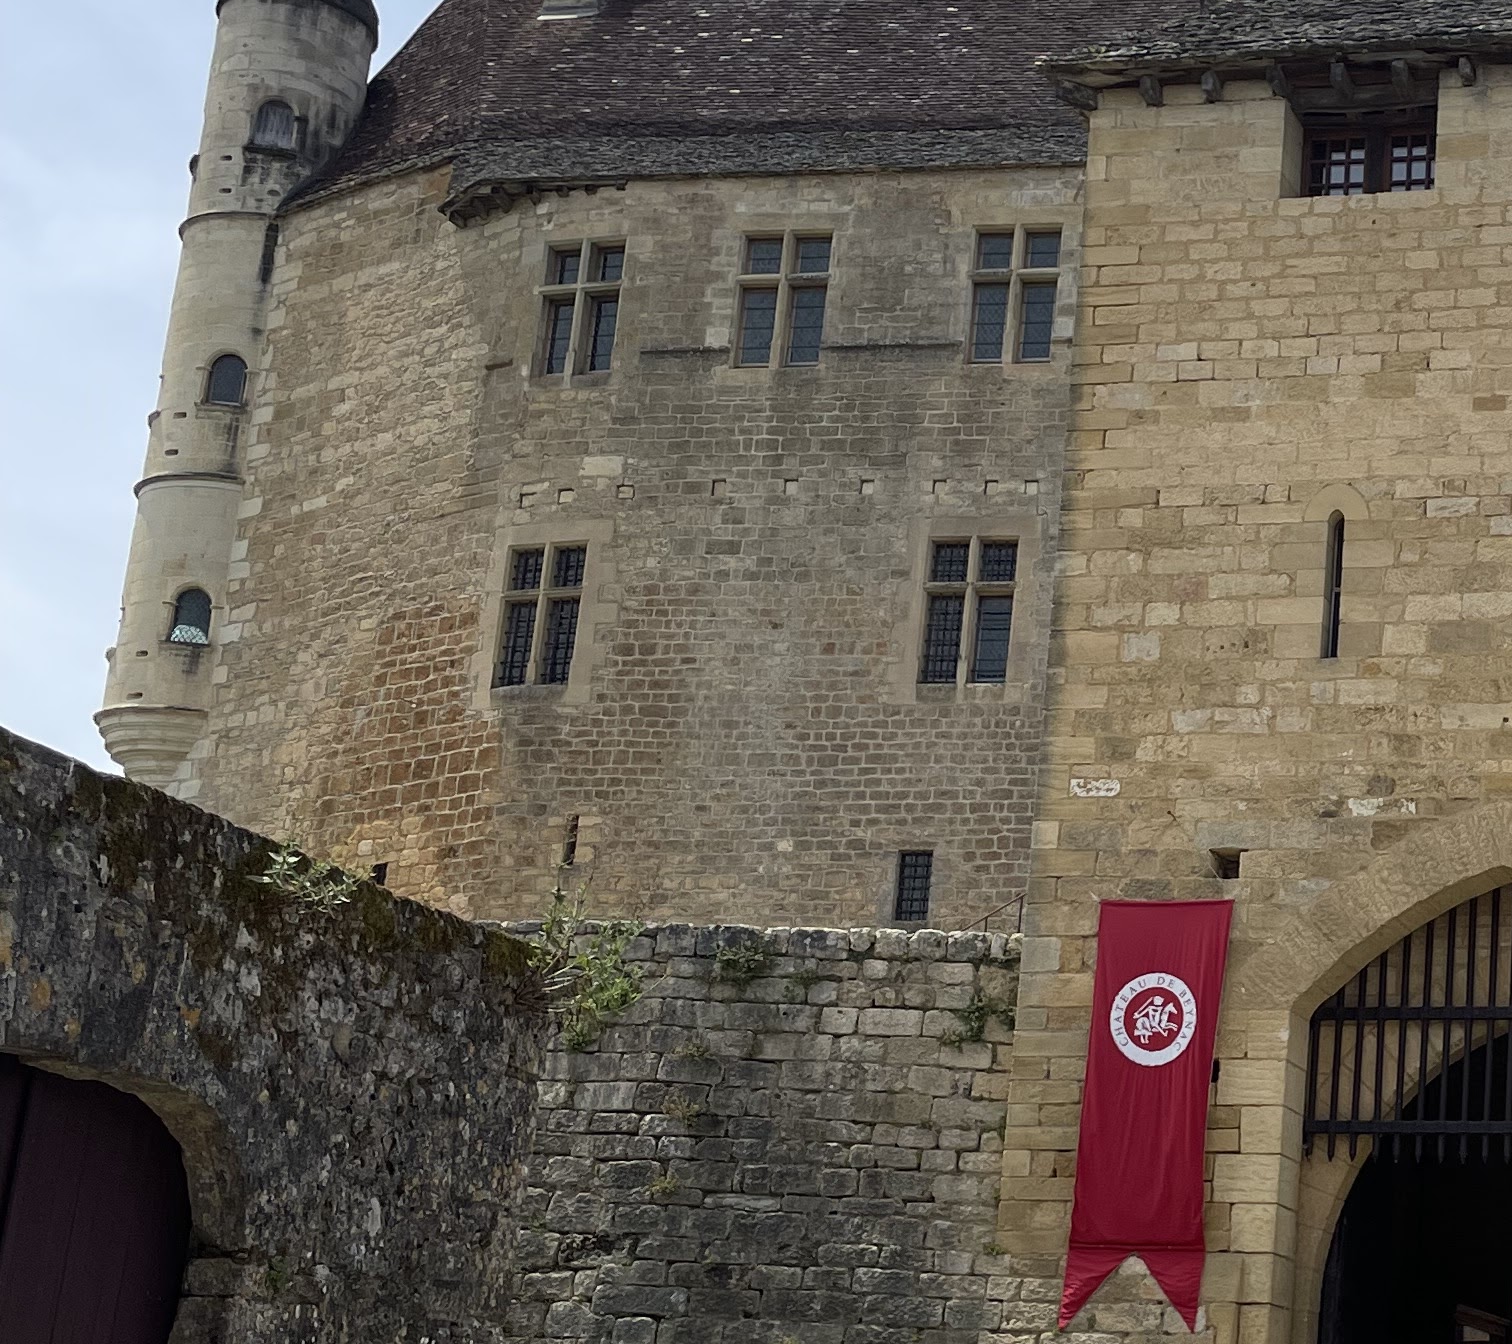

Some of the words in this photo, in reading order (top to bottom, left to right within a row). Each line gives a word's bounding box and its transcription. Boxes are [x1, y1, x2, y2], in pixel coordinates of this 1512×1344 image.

[1113, 979, 1147, 1047] CHATEAU
[1156, 976, 1176, 989] DE
[1173, 989, 1195, 1052] BEYNAC
